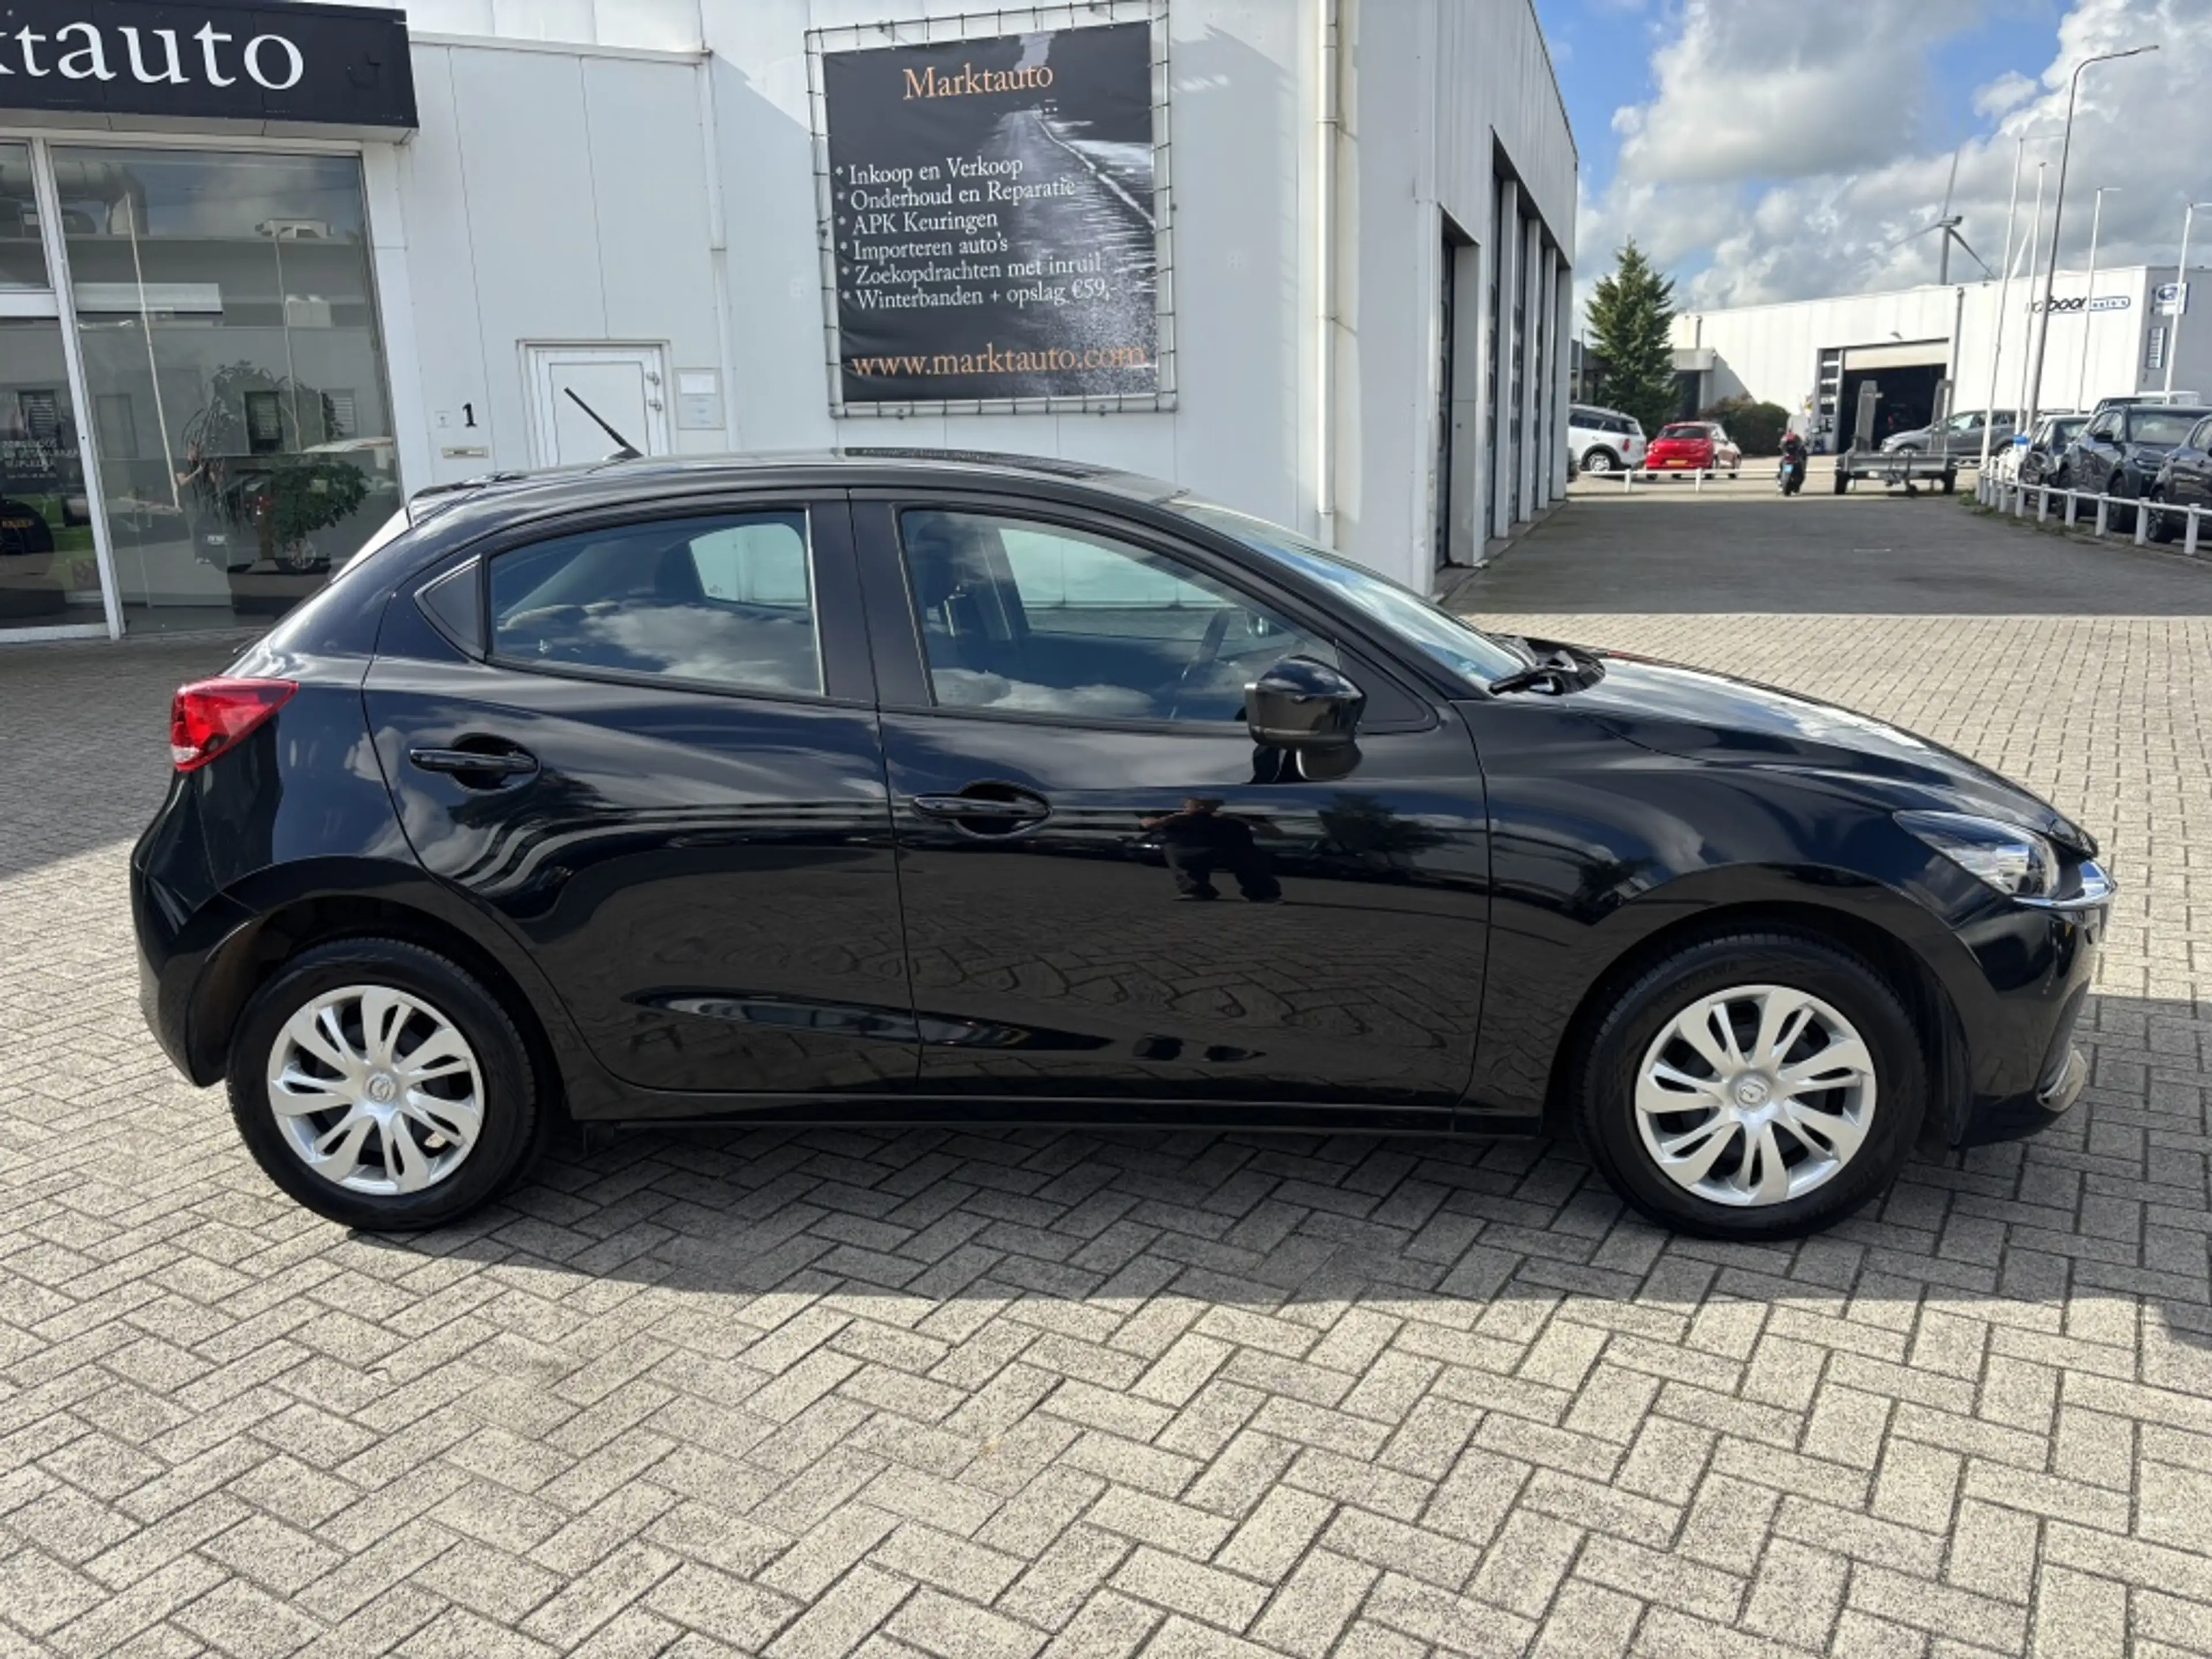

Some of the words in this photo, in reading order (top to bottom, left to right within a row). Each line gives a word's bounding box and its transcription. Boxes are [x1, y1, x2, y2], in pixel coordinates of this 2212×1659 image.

[0, 21, 304, 90] tauto
[902, 63, 1054, 100] Marktauto
[849, 164, 913, 188] Inkoop
[919, 165, 941, 180] en
[946, 156, 1023, 181] Verkoop
[850, 184, 953, 210] Onderhoud
[959, 187, 980, 203] en
[986, 177, 1076, 206] Reparatie
[852, 214, 898, 236] APK
[903, 211, 999, 235] Keuringen
[853, 239, 953, 266] Importeren
[959, 232, 1009, 255] auto's
[855, 259, 1002, 287] Zoekopdrachten
[1007, 259, 1043, 276] met
[1048, 251, 1102, 275] inruil
[856, 285, 984, 310] Winterbanden
[989, 290, 1001, 303] +
[1006, 281, 1066, 308] opslag
[851, 341, 1147, 377] www.marktauto.com
[461, 402, 478, 429] 1
